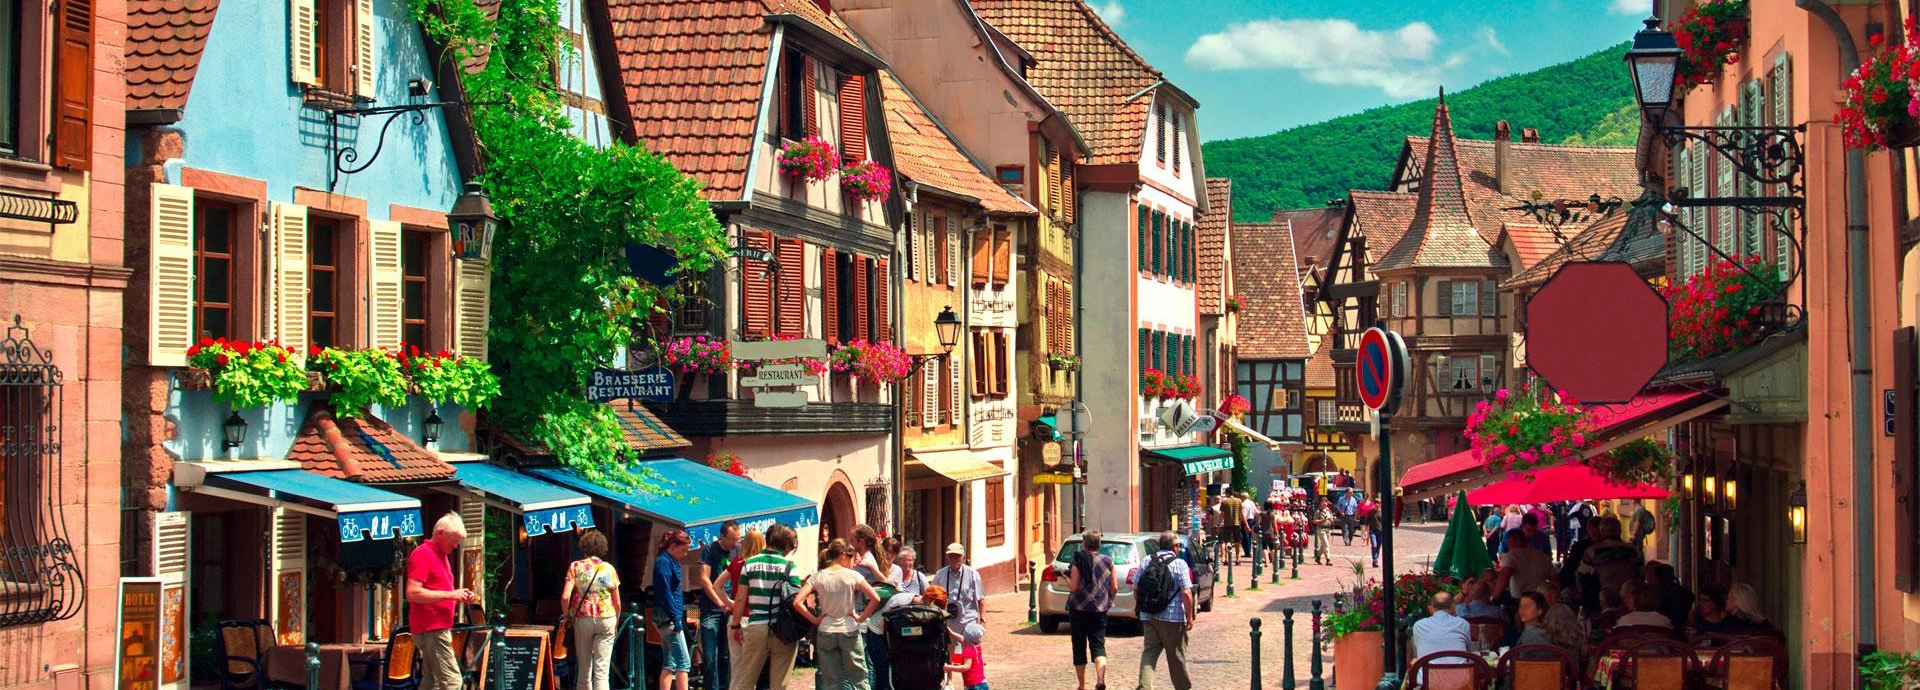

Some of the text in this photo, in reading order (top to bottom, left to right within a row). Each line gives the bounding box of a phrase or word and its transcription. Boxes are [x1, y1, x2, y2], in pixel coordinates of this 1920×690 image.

[594, 371, 667, 387] BRASSERIE
[758, 370, 803, 380] RESTAURANT
[588, 385, 672, 400] RESTAURANT
[1176, 414, 1197, 435] PRESSE
[125, 593, 155, 606] HOTEL
